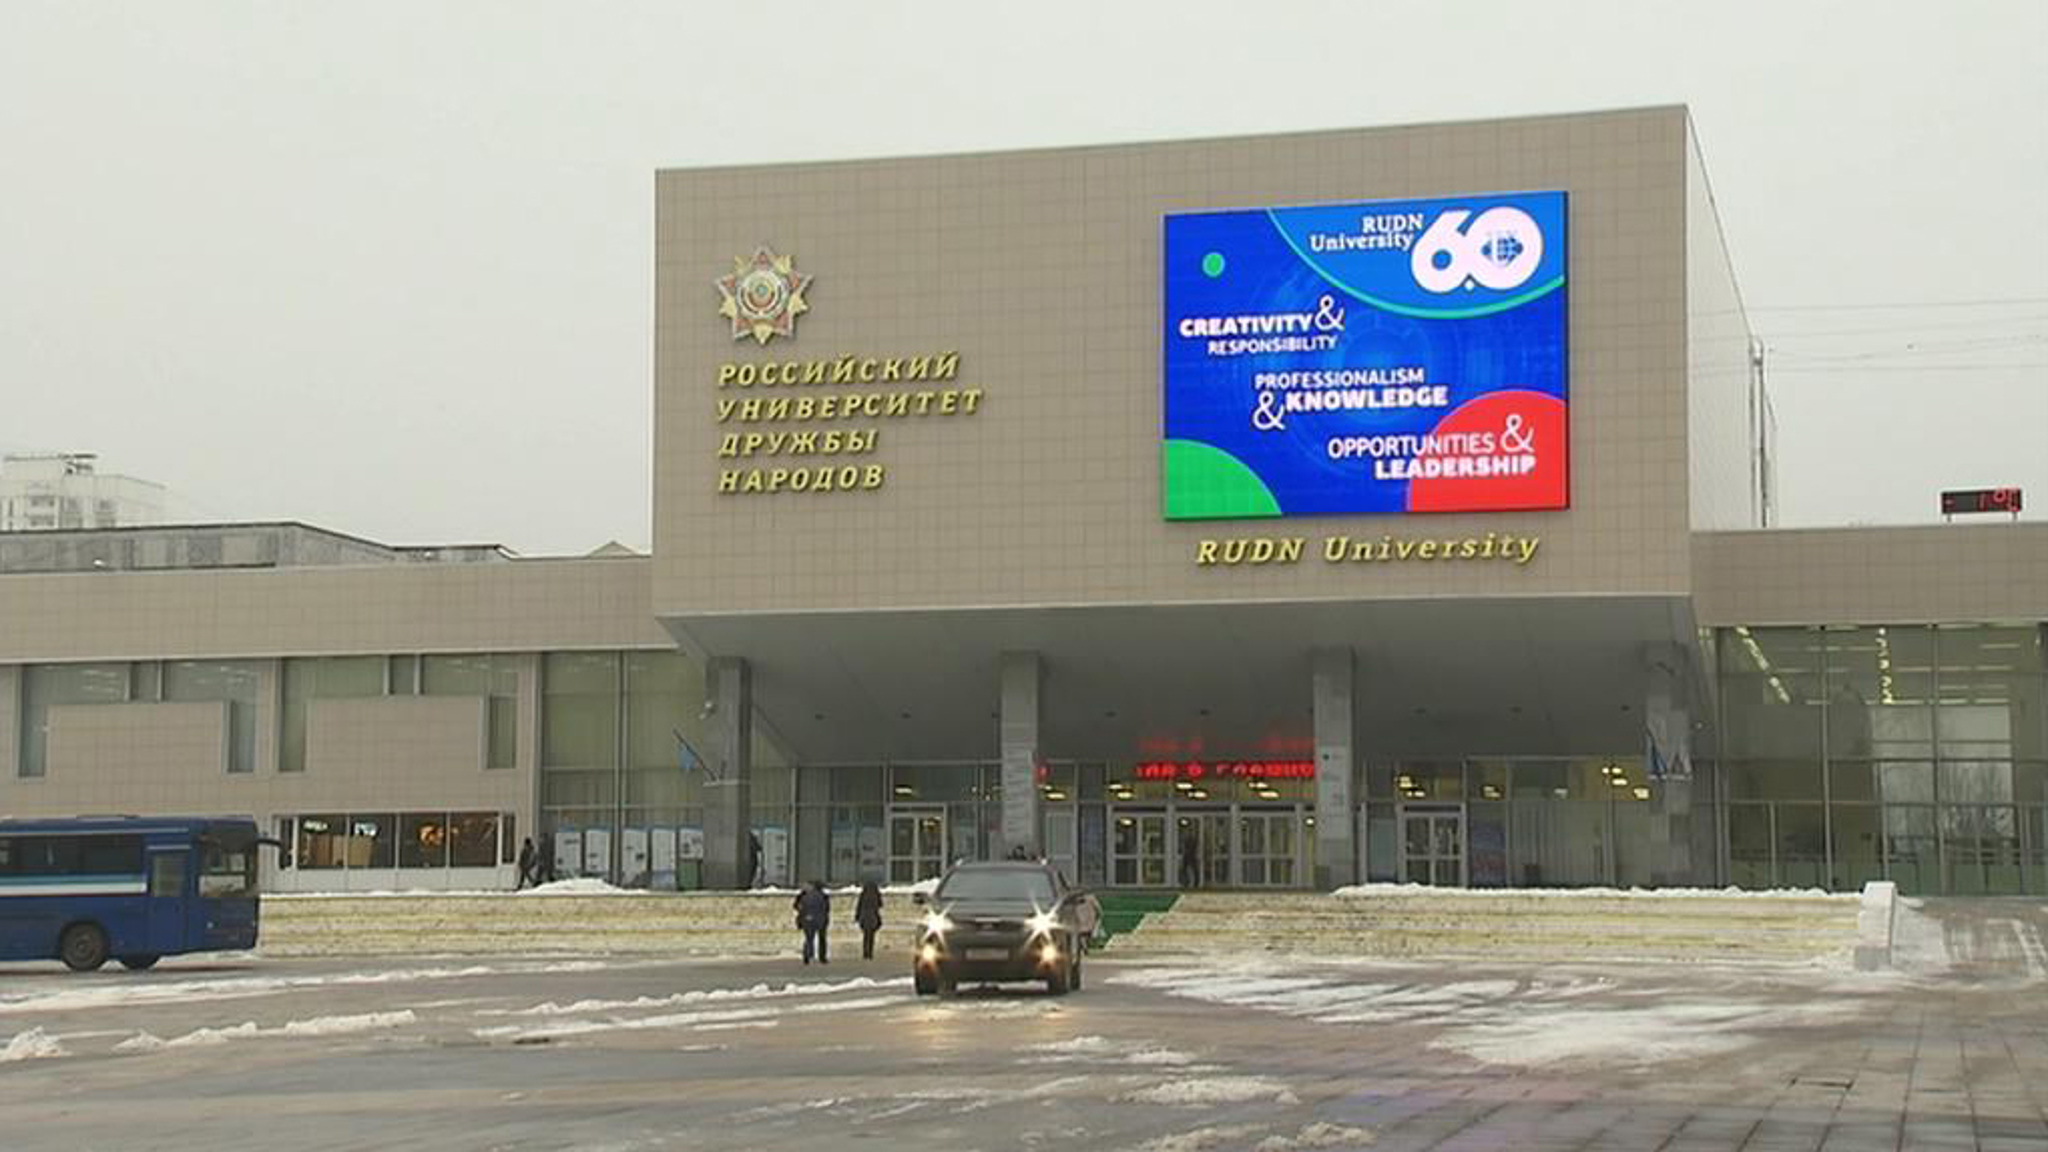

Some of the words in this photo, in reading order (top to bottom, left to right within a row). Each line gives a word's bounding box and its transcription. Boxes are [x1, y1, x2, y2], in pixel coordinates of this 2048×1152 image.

[1362, 213, 1423, 234] RUDN
[1309, 229, 1415, 252] University
[1179, 312, 1314, 337] CREATIVITY
[1314, 294, 1345, 331] &
[1207, 335, 1338, 356] RESPONSIBILITY
[717, 351, 961, 387] РОССИЙСКИЙ
[1255, 368, 1425, 389] PROFESSIONALISM
[716, 389, 983, 423] УНИВЕРСИТЕТ
[1252, 391, 1286, 430] &
[1285, 386, 1449, 412] KNOWLEDGE
[718, 428, 879, 458] ДРУЖБЫ
[1327, 431, 1495, 458] OPPORTUNITIES
[1500, 414, 1534, 454] &
[718, 464, 885, 493] НАРОДОВ
[1374, 455, 1537, 480] LEADERSHIP
[1196, 536, 1305, 564] RUDN
[1324, 532, 1540, 564] University
